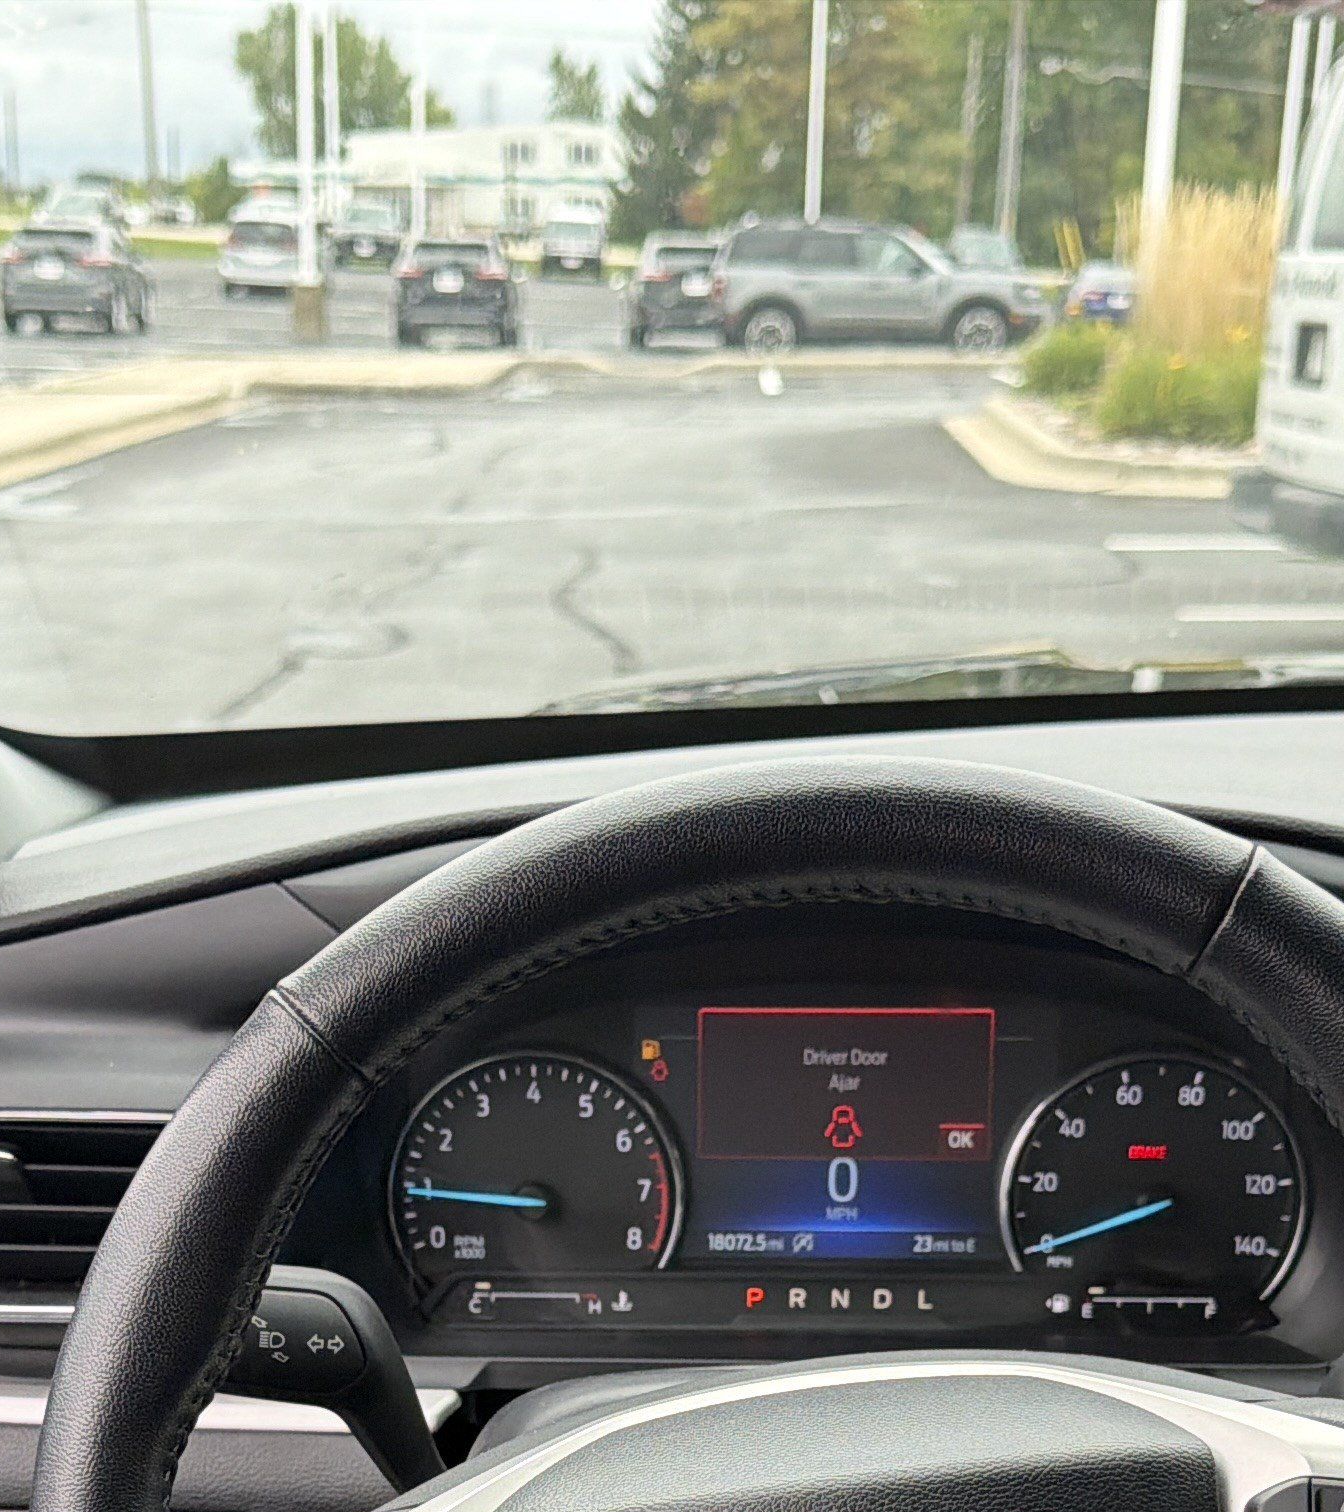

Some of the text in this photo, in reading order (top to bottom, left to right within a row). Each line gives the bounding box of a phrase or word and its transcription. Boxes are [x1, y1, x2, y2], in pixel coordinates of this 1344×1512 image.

[803, 1048, 888, 1066] Driver Door
[526, 1080, 541, 1103] 4
[828, 1074, 861, 1092] Ajar
[476, 1094, 490, 1117] 3
[578, 1093, 594, 1117] 5
[1116, 1085, 1143, 1106] 60
[1178, 1085, 1205, 1106] 80
[1058, 1117, 1086, 1139] 40
[1221, 1119, 1254, 1141] 100
[438, 1128, 452, 1151] 2
[615, 1128, 632, 1152] 6
[947, 1130, 975, 1149] OK
[1128, 1145, 1168, 1160] BRAKE
[637, 1178, 652, 1202] 7
[827, 1157, 858, 1202] 0
[1032, 1171, 1058, 1193] 20
[1244, 1174, 1276, 1195] 120
[825, 1207, 859, 1221] MPH
[429, 1225, 446, 1249] 0
[626, 1226, 642, 1250] 8
[1233, 1235, 1267, 1256] 140
[746, 1287, 934, 1310] P R N D L
